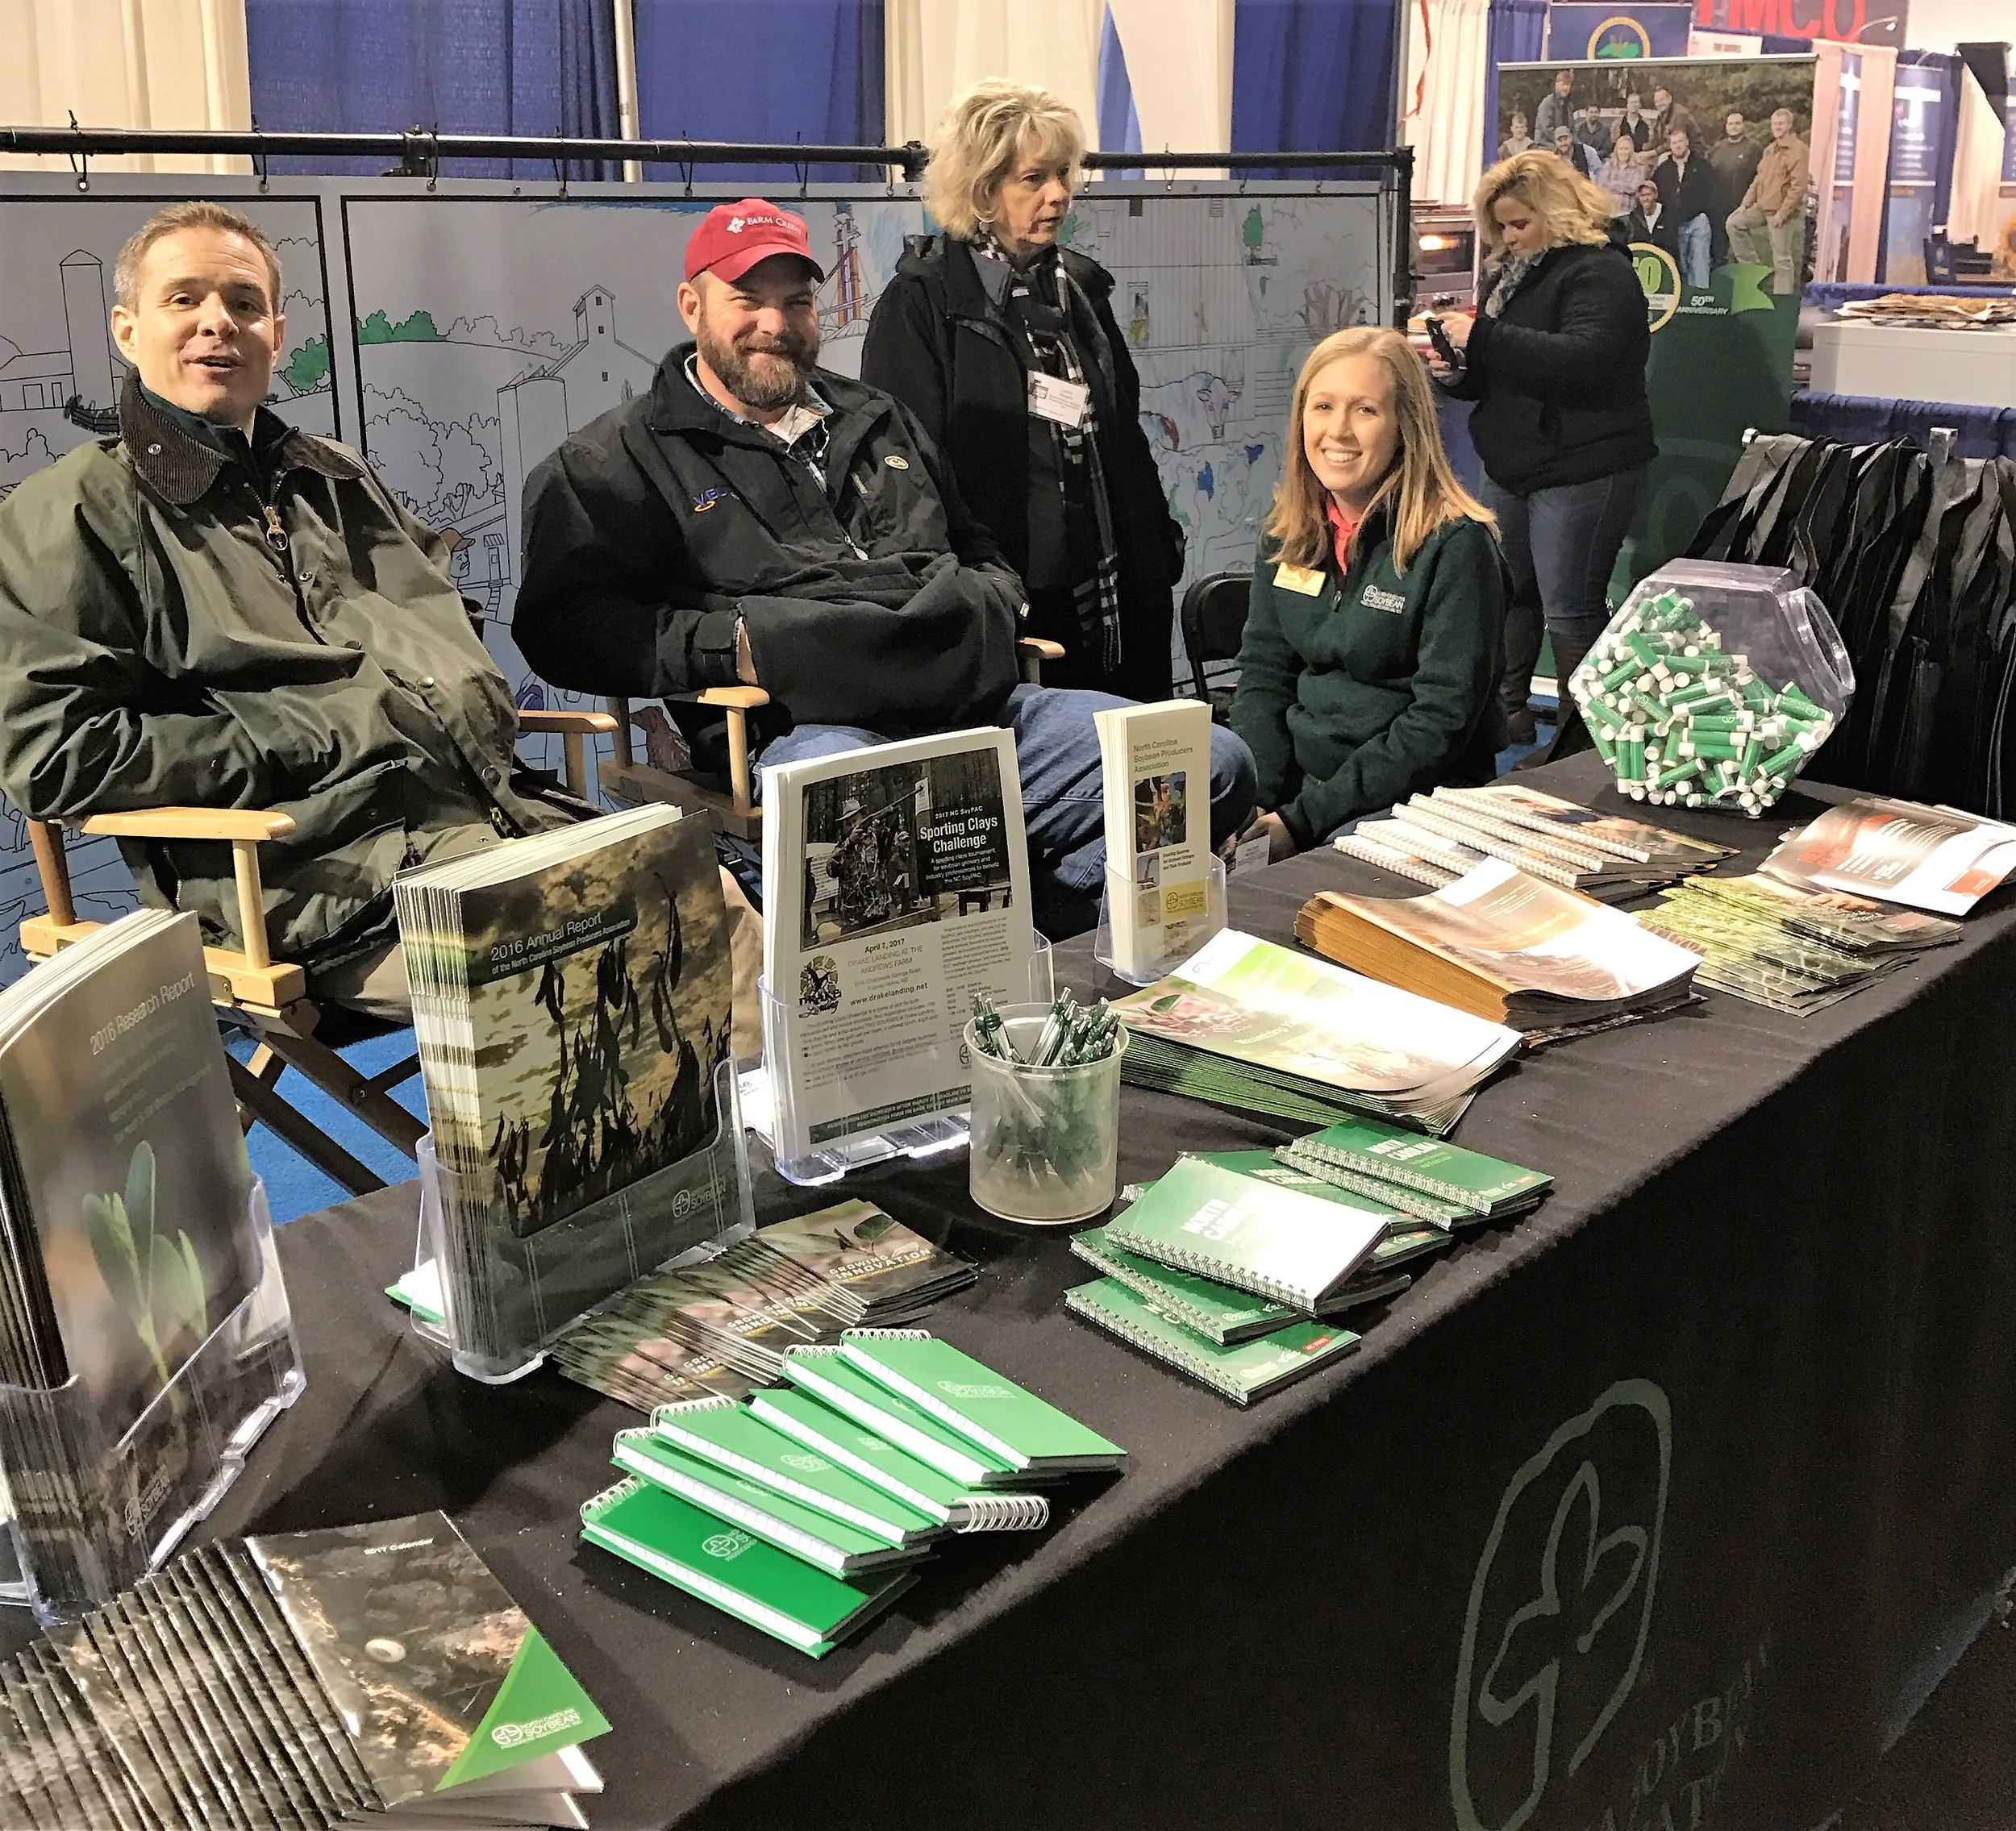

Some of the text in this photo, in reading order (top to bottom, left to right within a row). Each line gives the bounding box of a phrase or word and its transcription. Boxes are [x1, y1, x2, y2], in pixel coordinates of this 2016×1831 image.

[747, 216, 773, 226] FARM
[1133, 739, 1177, 752] North Carolina
[1134, 747, 1193, 763] Soybean Producers
[1134, 761, 1169, 773] Association
[935, 811, 948, 819] 2017
[960, 806, 983, 814] SoyPAC
[919, 817, 998, 841] Sporting Clays
[933, 834, 987, 853] Challenge
[490, 912, 602, 962] 2016 Annual Report
[864, 938, 906, 955] April 7, 2017
[491, 966, 499, 975] of
[500, 961, 510, 972] the
[511, 956, 527, 969] North
[528, 947, 552, 963] Carolina
[552, 940, 576, 955] Soybean
[576, 930, 602, 945] Producers
[848, 957, 869, 968] DRAKE
[872, 950, 901, 962] LANDING
[910, 945, 923, 954] THE
[860, 957, 913, 975] ANDREWS FARM
[850, 982, 928, 1006] www.drakelanding.net
[90, 971, 195, 1055] 2016 Research Report
[1364, 1138, 1408, 1155] NORTH
[1386, 1142, 1442, 1161] CAROLINA
[828, 1254, 889, 1275] GROWING
[835, 1247, 932, 1280] INNOVATION
[389, 1537, 435, 1551] Calendar
[523, 1712, 581, 1737] SOYBEAN
